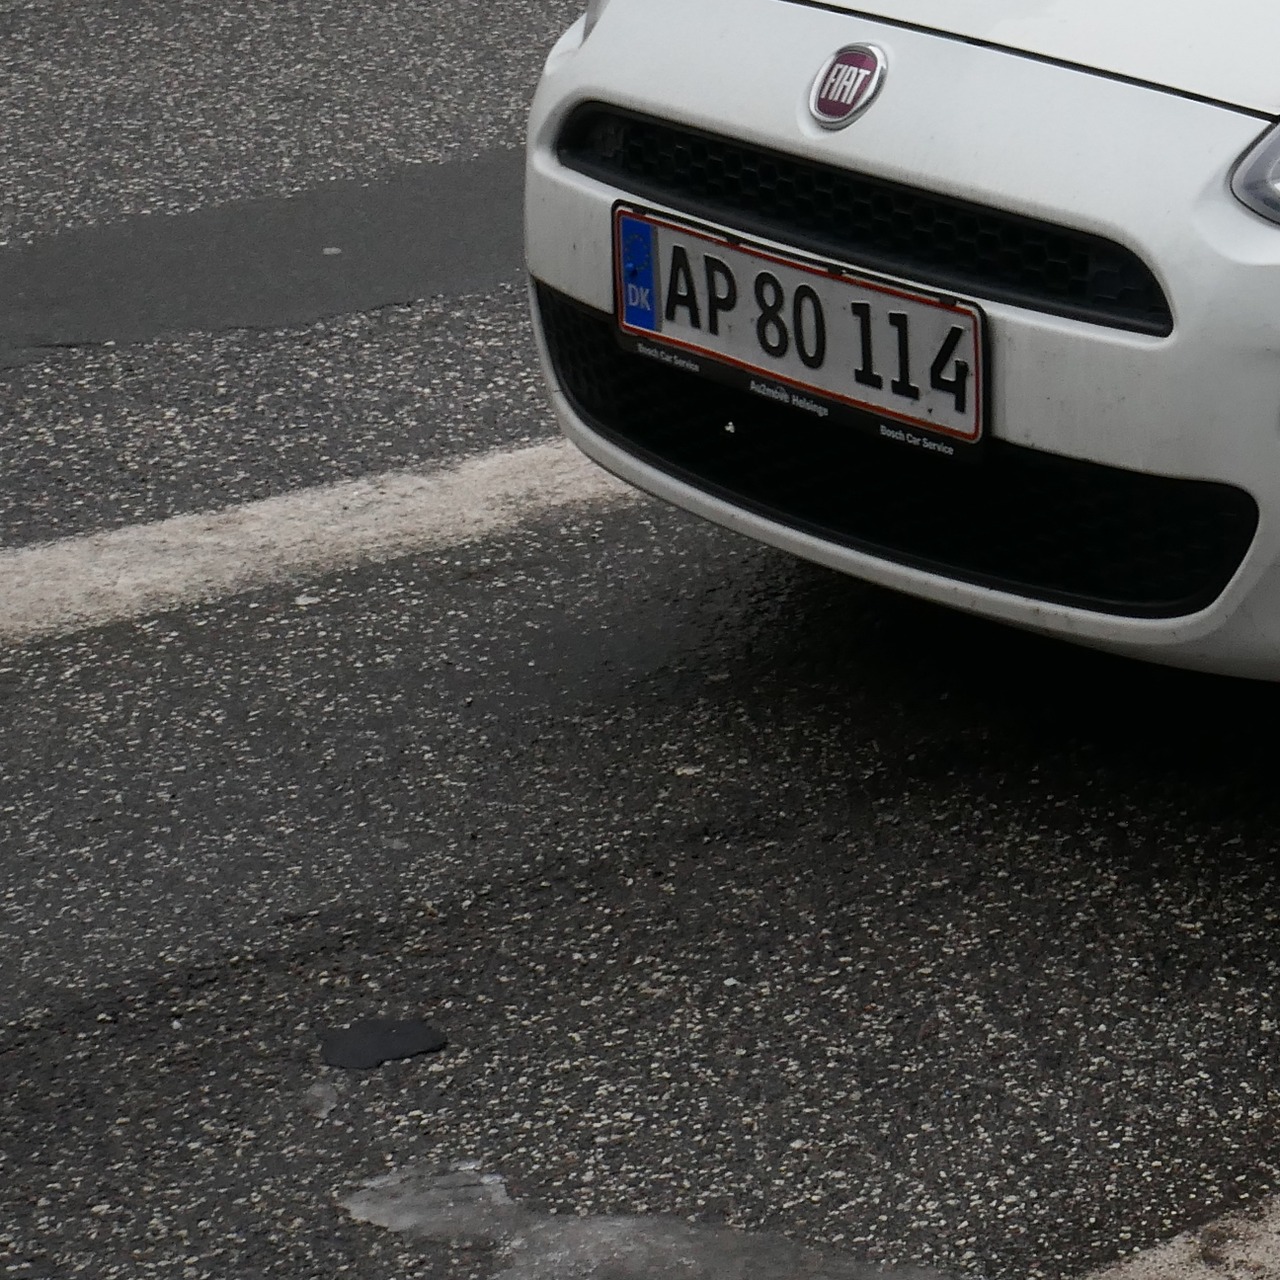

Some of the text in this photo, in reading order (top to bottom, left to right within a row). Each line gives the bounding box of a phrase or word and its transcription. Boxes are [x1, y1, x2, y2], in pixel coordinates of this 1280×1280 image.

[820, 63, 871, 104] FIAT
[627, 283, 651, 311] DK
[665, 245, 970, 414] AP 80 114
[879, 425, 954, 456] Bosch Car Service
